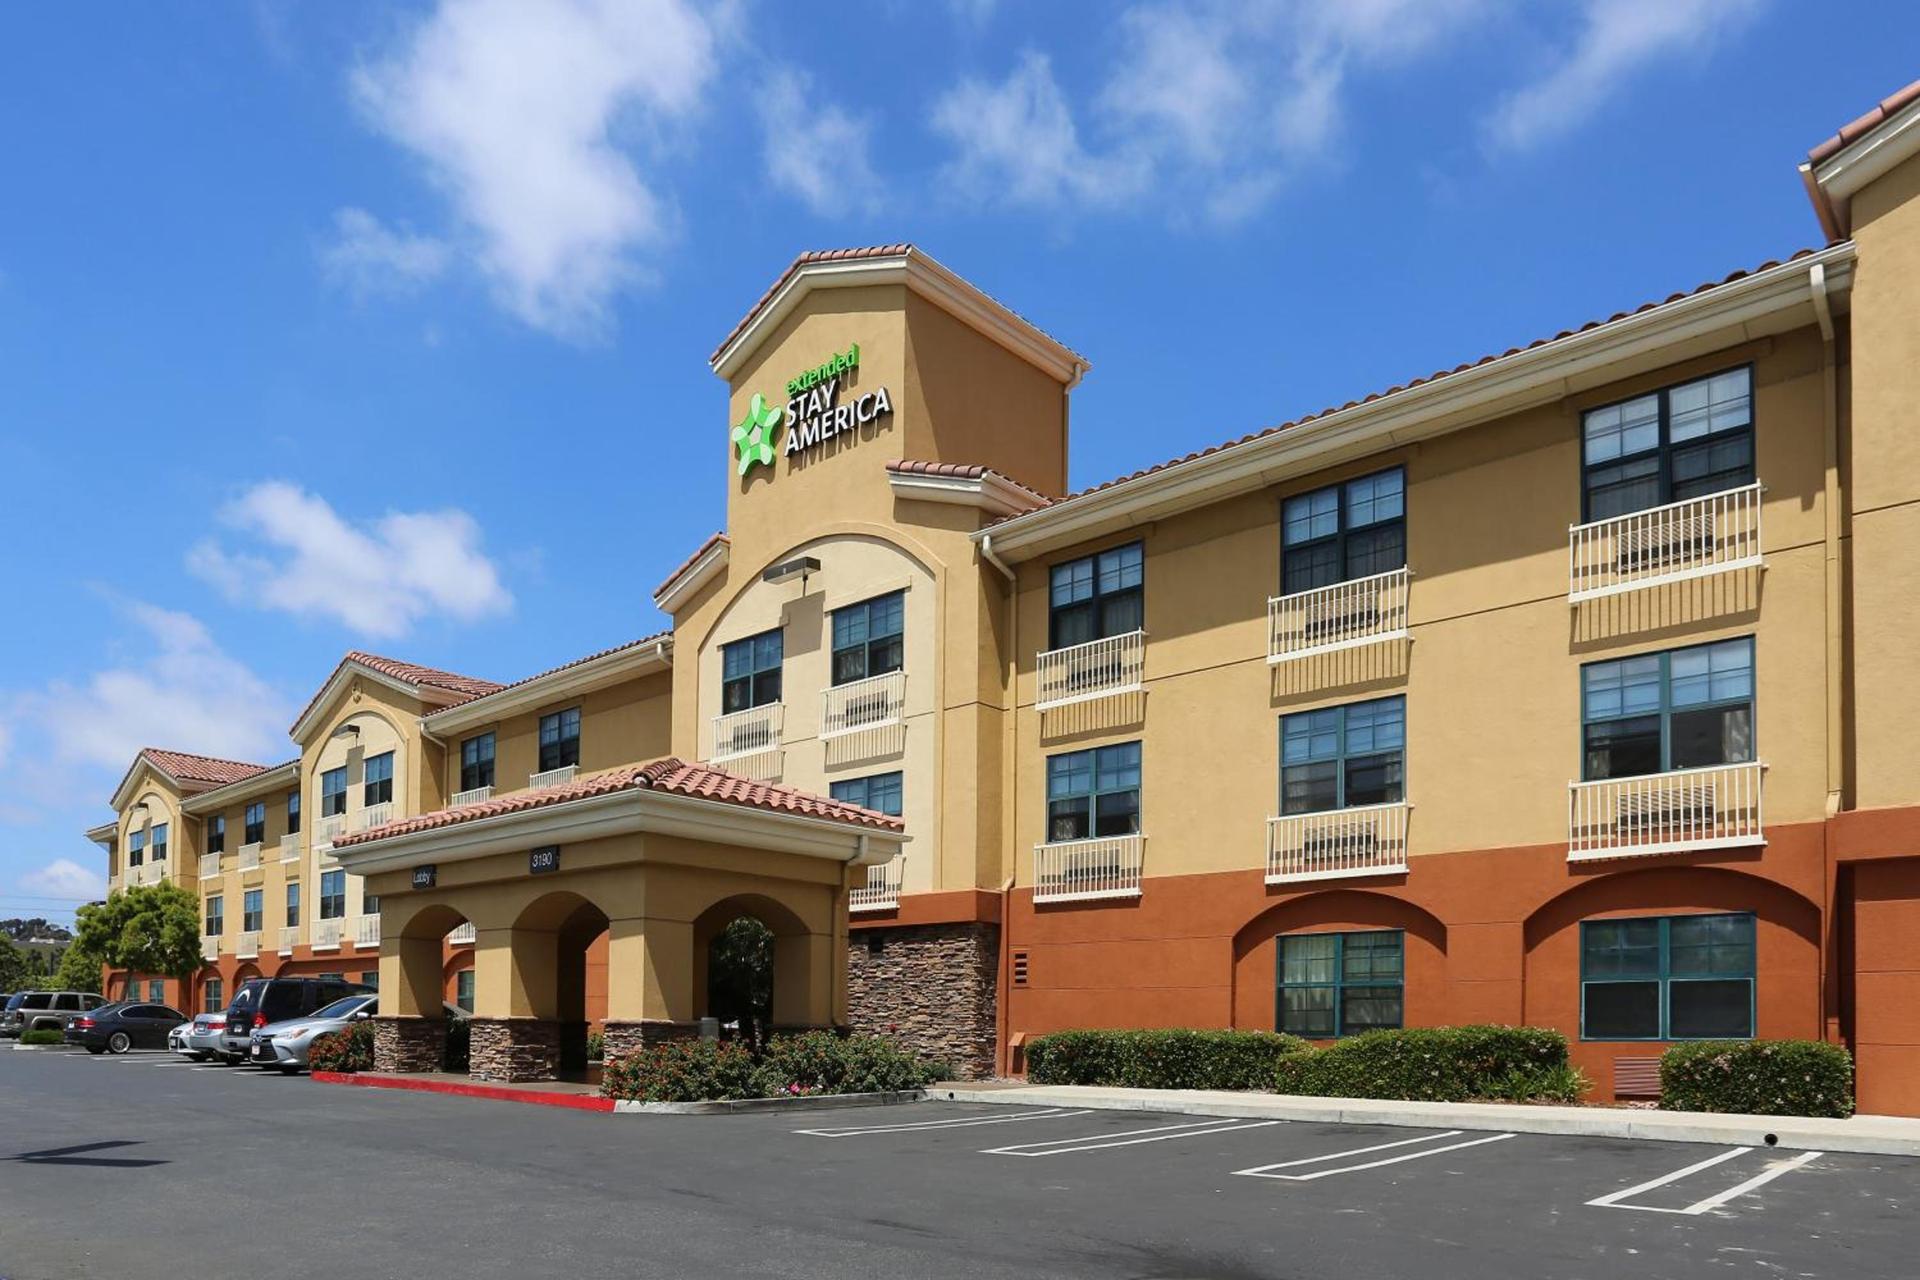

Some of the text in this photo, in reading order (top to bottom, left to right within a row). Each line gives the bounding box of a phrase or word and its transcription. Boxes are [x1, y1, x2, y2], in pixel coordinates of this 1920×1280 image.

[786, 342, 860, 394] extended
[785, 387, 891, 456] AMERICA
[786, 379, 837, 427] STAY
[413, 871, 431, 885] Lobby
[532, 852, 552, 868] 3190
